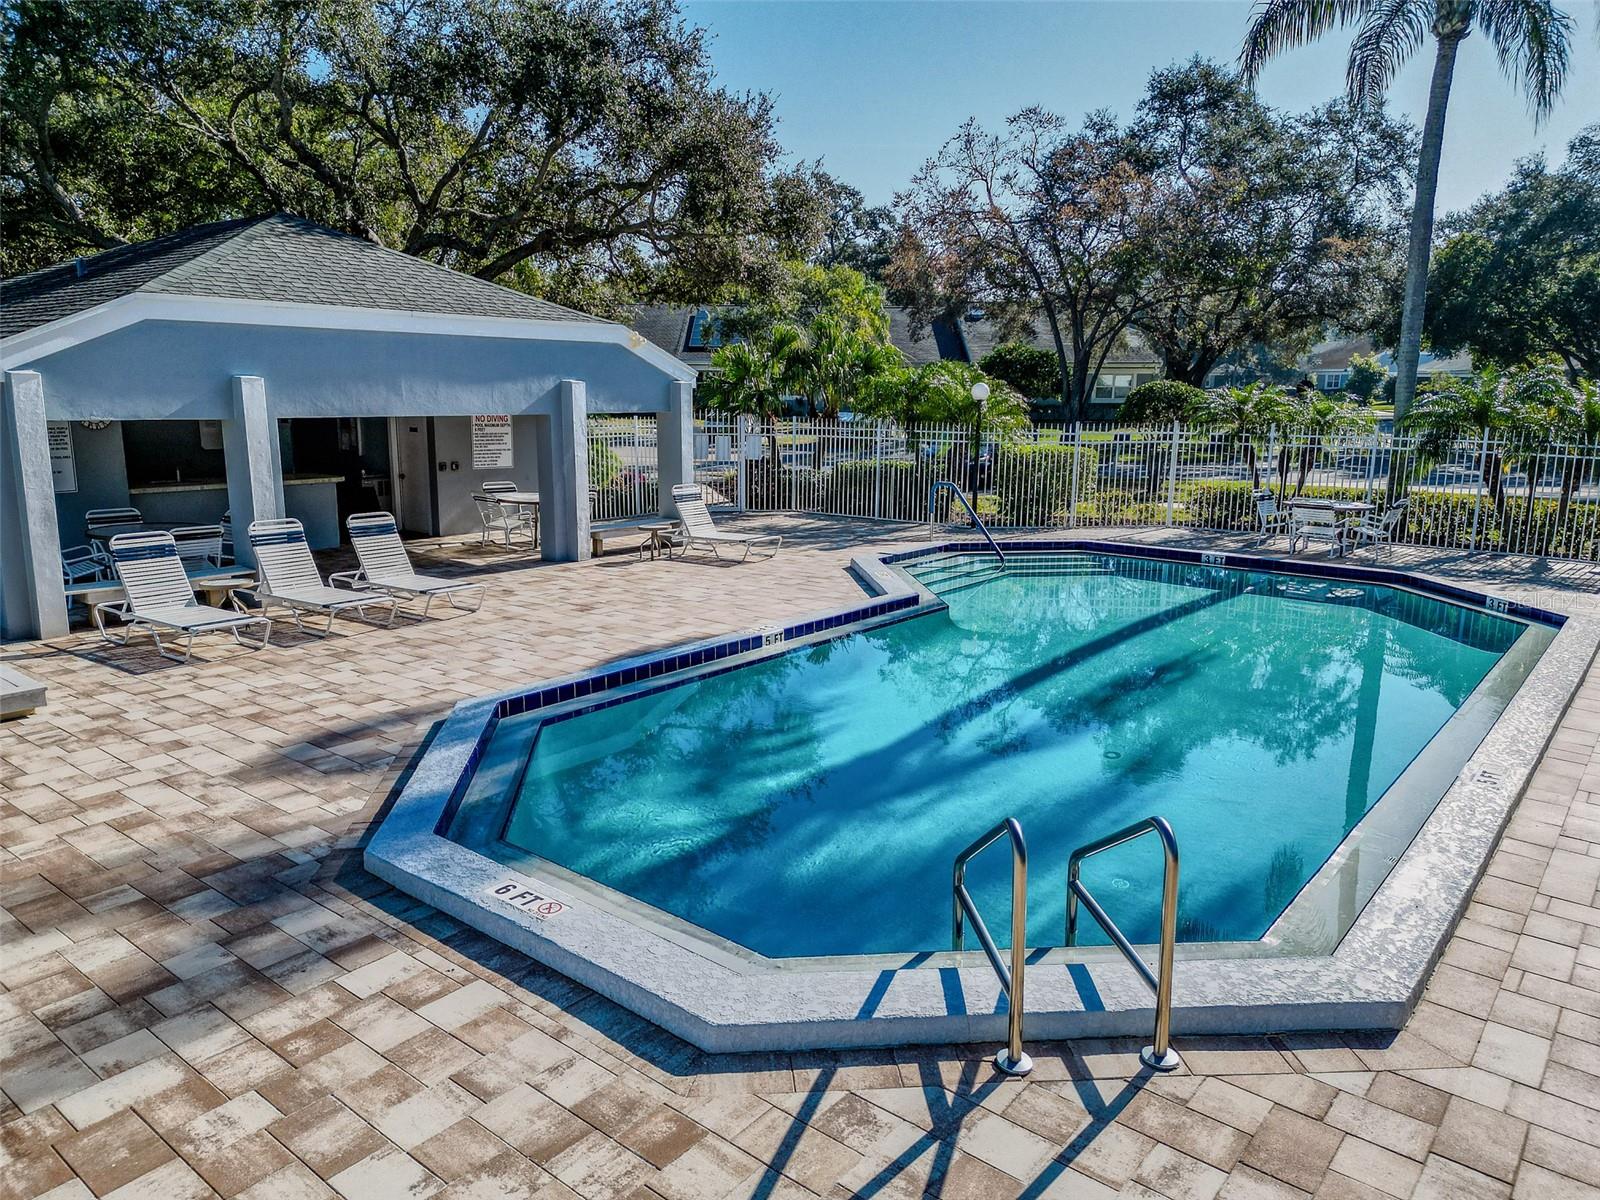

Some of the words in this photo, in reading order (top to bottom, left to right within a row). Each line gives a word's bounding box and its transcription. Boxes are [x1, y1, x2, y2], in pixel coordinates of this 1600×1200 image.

[475, 415, 486, 423] NO
[487, 415, 509, 423] DIVING
[1204, 554, 1210, 565] 3
[1214, 556, 1225, 566] FT
[1488, 598, 1495, 609] 3
[1497, 602, 1508, 613] FT
[765, 635, 771, 647] 5
[774, 631, 784, 645] FT
[494, 884, 518, 895] 6
[508, 891, 545, 906] FT
